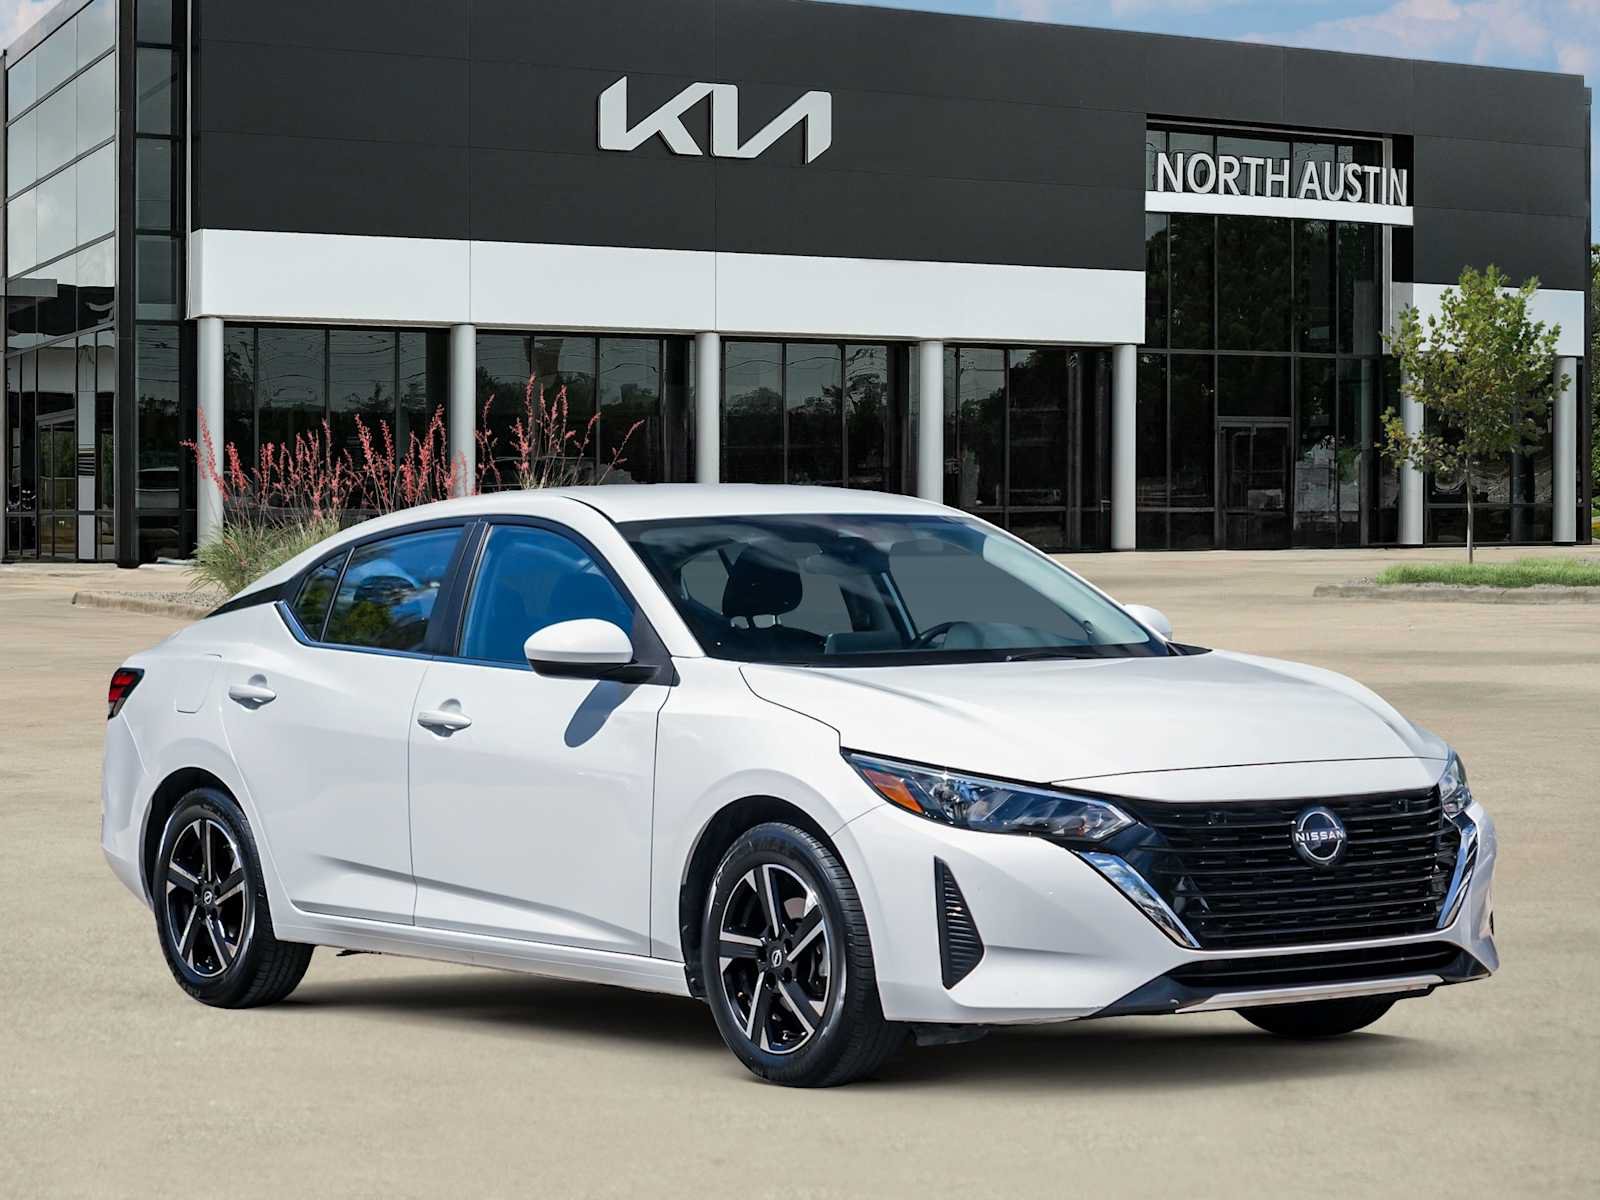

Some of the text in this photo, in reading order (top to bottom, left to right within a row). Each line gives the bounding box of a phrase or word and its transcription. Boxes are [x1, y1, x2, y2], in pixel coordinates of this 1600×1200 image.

[599, 75, 832, 164] KIA
[1157, 152, 1408, 207] NORTH AUSTIN
[1295, 830, 1344, 842] NISSAN
